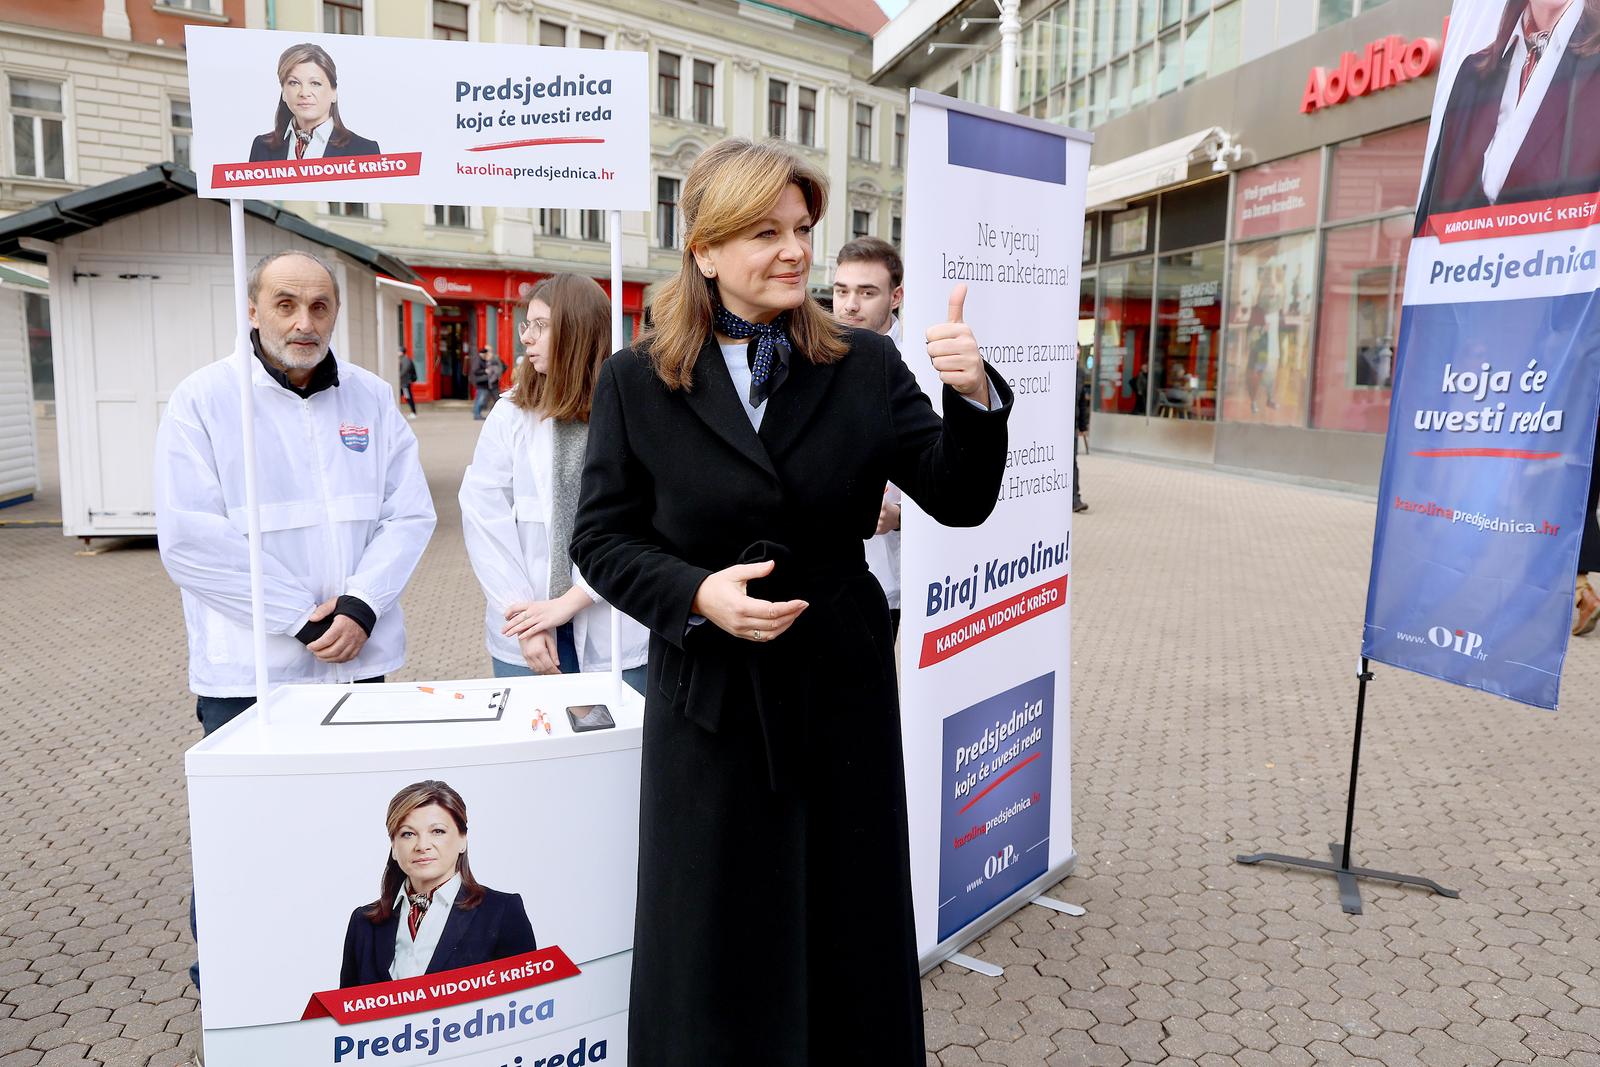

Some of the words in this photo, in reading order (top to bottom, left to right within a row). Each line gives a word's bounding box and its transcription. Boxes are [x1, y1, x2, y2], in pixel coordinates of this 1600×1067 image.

[456, 74, 612, 105] Predsjednica
[1299, 34, 1438, 113] Addiko
[456, 112, 493, 132] koja
[499, 110, 516, 127] će
[521, 107, 570, 125] uvesti
[575, 106, 612, 122] reda
[224, 166, 298, 182] KAROLINA
[299, 160, 356, 177] VIDOVIĆ
[358, 157, 407, 173] KRIŠTO
[456, 162, 615, 181] karolinapredsjednica.hr
[1445, 217, 1493, 234] KAROLINA
[1497, 207, 1553, 227] VIDOVIĆ
[978, 222, 997, 248] Ne
[1000, 225, 1040, 258] vjeruj
[942, 253, 994, 282] lažnim
[997, 259, 1069, 286] anketama!
[1430, 245, 1596, 288] Predsjednica
[1027, 344, 1075, 362] razumu
[1019, 371, 1051, 394] srcu!
[1442, 362, 1512, 402] koja
[1519, 358, 1548, 393] će
[1414, 402, 1506, 433] uvesti
[1509, 401, 1564, 433] reda
[1005, 440, 1055, 468] avednu
[1394, 496, 1561, 536] karolinapredsjednica.hr
[926, 564, 978, 618] Biraj
[984, 531, 1070, 594] Karolinu!
[936, 618, 987, 654] KAROLINA
[987, 598, 1026, 630] VIDOVIĆ
[1027, 587, 1058, 613] KRIŠTO
[955, 699, 1043, 773] Predsjednica
[954, 776, 977, 800] koja
[979, 762, 990, 781] će
[992, 742, 1020, 776] uvesti
[1021, 726, 1042, 755] reda
[953, 792, 1041, 849] karolinapredsjednica.hr
[343, 987, 427, 1013] KAROLINA
[429, 970, 497, 999] VIDOVIĆ
[500, 958, 555, 984] KRIŠTO
[333, 998, 555, 1064] Predsjednica
